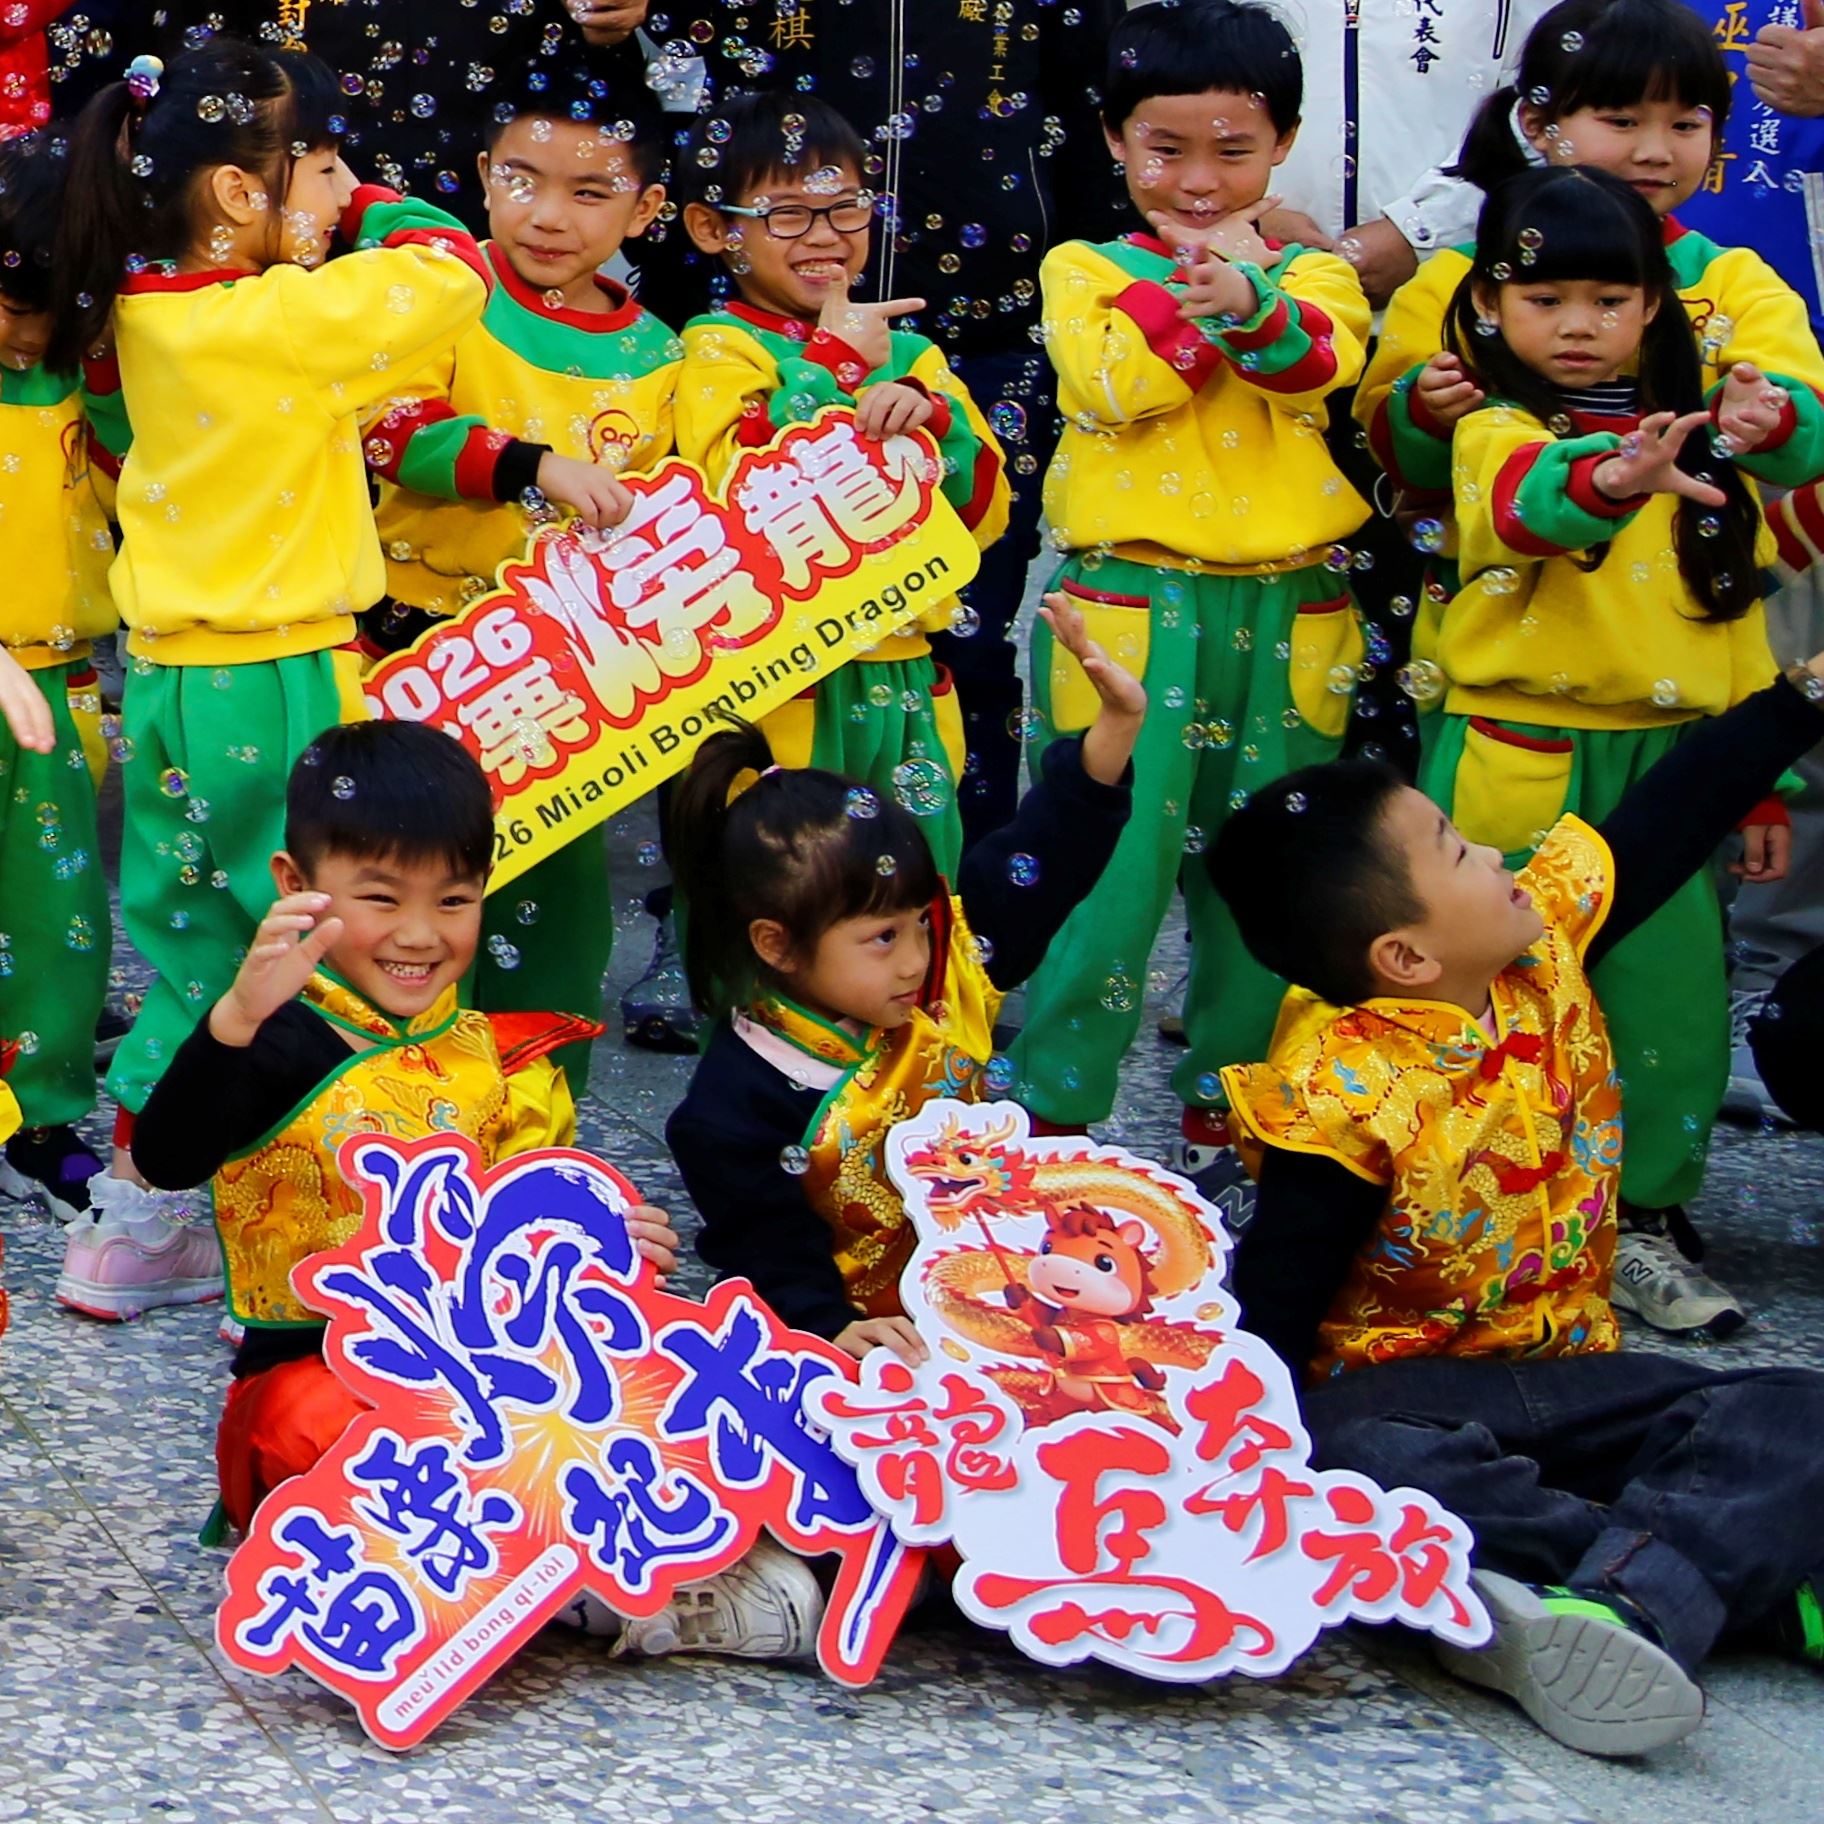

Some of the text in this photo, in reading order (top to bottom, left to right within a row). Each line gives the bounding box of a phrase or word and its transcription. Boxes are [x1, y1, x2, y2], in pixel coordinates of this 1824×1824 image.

[535, 742, 652, 831] Miaoli
[650, 639, 820, 758] Bombing
[814, 552, 952, 649] Dragon
[463, 1606, 515, 1652] bong
